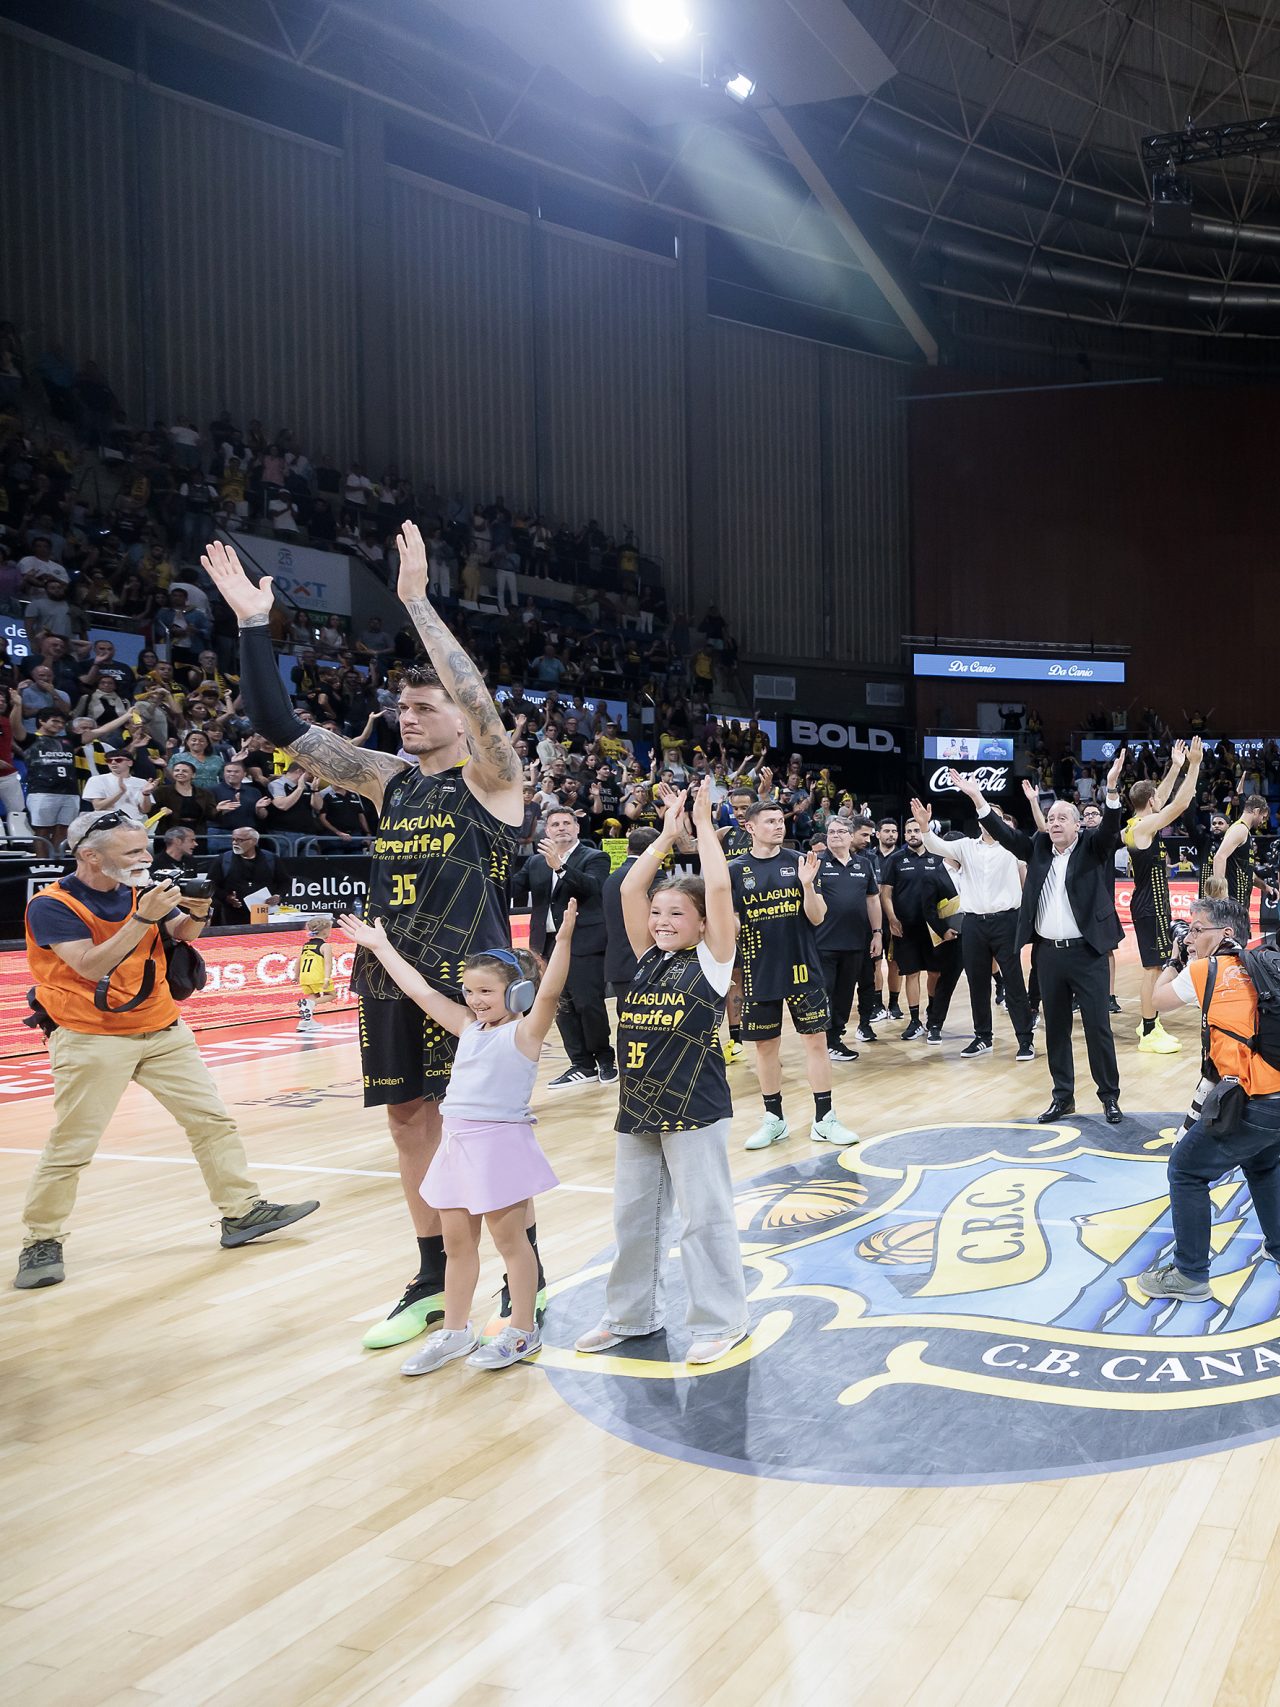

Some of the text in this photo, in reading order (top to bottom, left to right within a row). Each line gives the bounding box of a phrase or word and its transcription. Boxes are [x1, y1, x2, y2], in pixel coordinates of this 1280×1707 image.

[5, 624, 28, 638] de
[948, 660, 996, 674] Da Canio
[1048, 665, 1094, 677] Da Canio
[791, 719, 901, 753] BOLD.
[38, 750, 73, 758] Lenovo
[57, 766, 67, 777] 9
[393, 814, 456, 831] LAGUNA
[285, 875, 366, 897] bellón
[389, 873, 417, 906] 35
[742, 888, 801, 905] LA LAGUNA
[311, 900, 347, 911] Martín
[302, 958, 314, 973] 11
[792, 964, 809, 984] 10
[632, 992, 685, 1006] LAGUNA
[626, 1041, 648, 1069] 35
[957, 1183, 1025, 1264] C.B.C.
[982, 1343, 1081, 1378] C.B.
